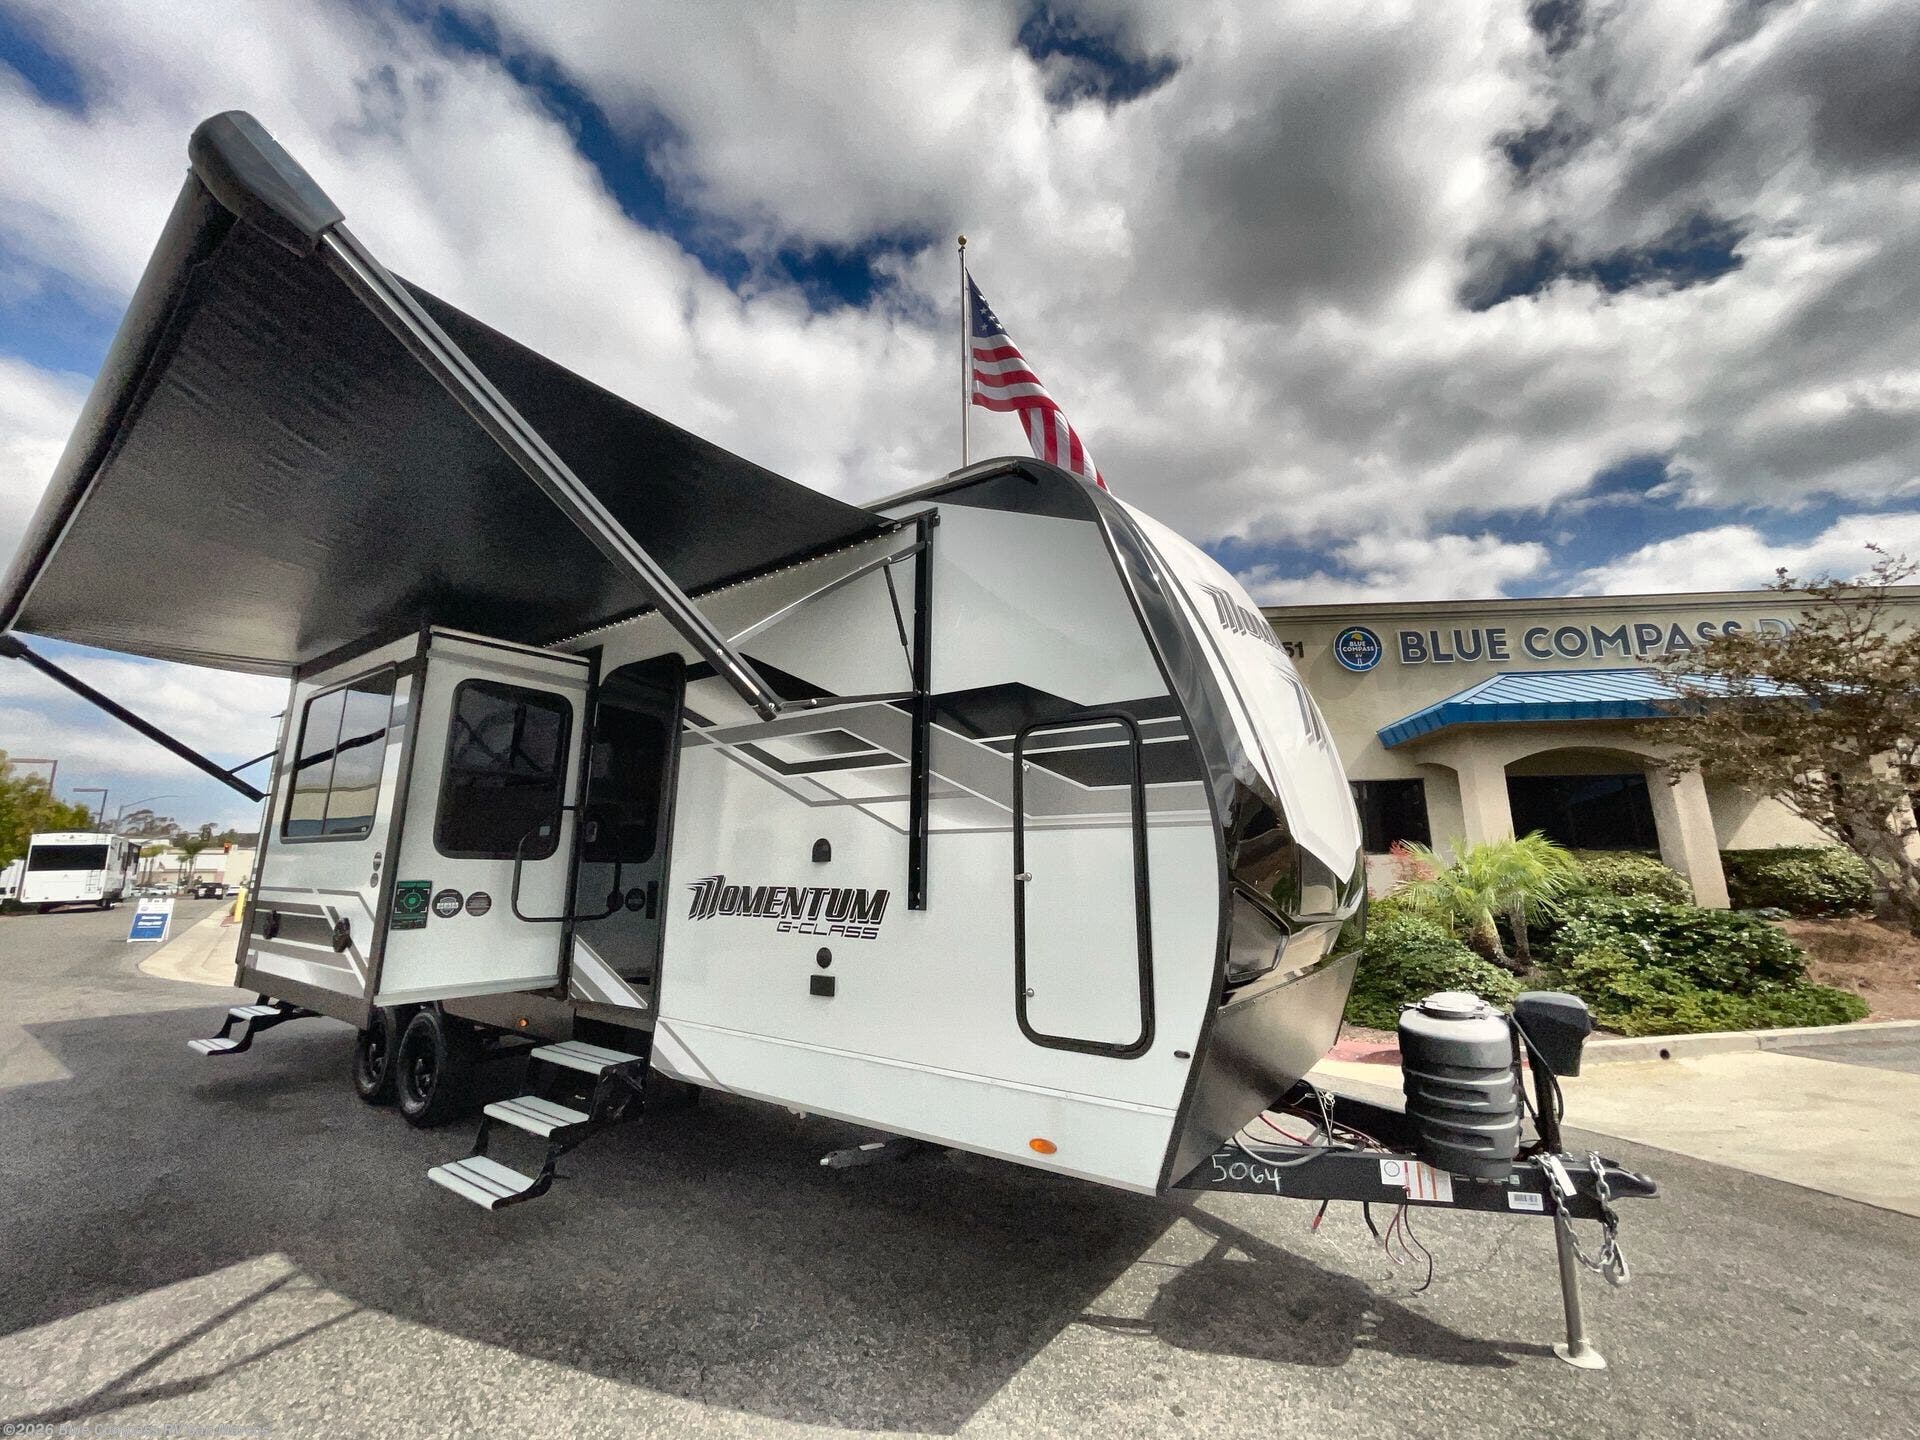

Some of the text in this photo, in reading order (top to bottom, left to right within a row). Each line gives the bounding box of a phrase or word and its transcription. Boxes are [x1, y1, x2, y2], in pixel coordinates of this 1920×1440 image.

[1398, 628, 1510, 663] BLUE
[1520, 621, 1742, 659] COMPASS
[777, 921, 879, 939] G-CLASS
[1212, 1154, 1281, 1194] 5064
